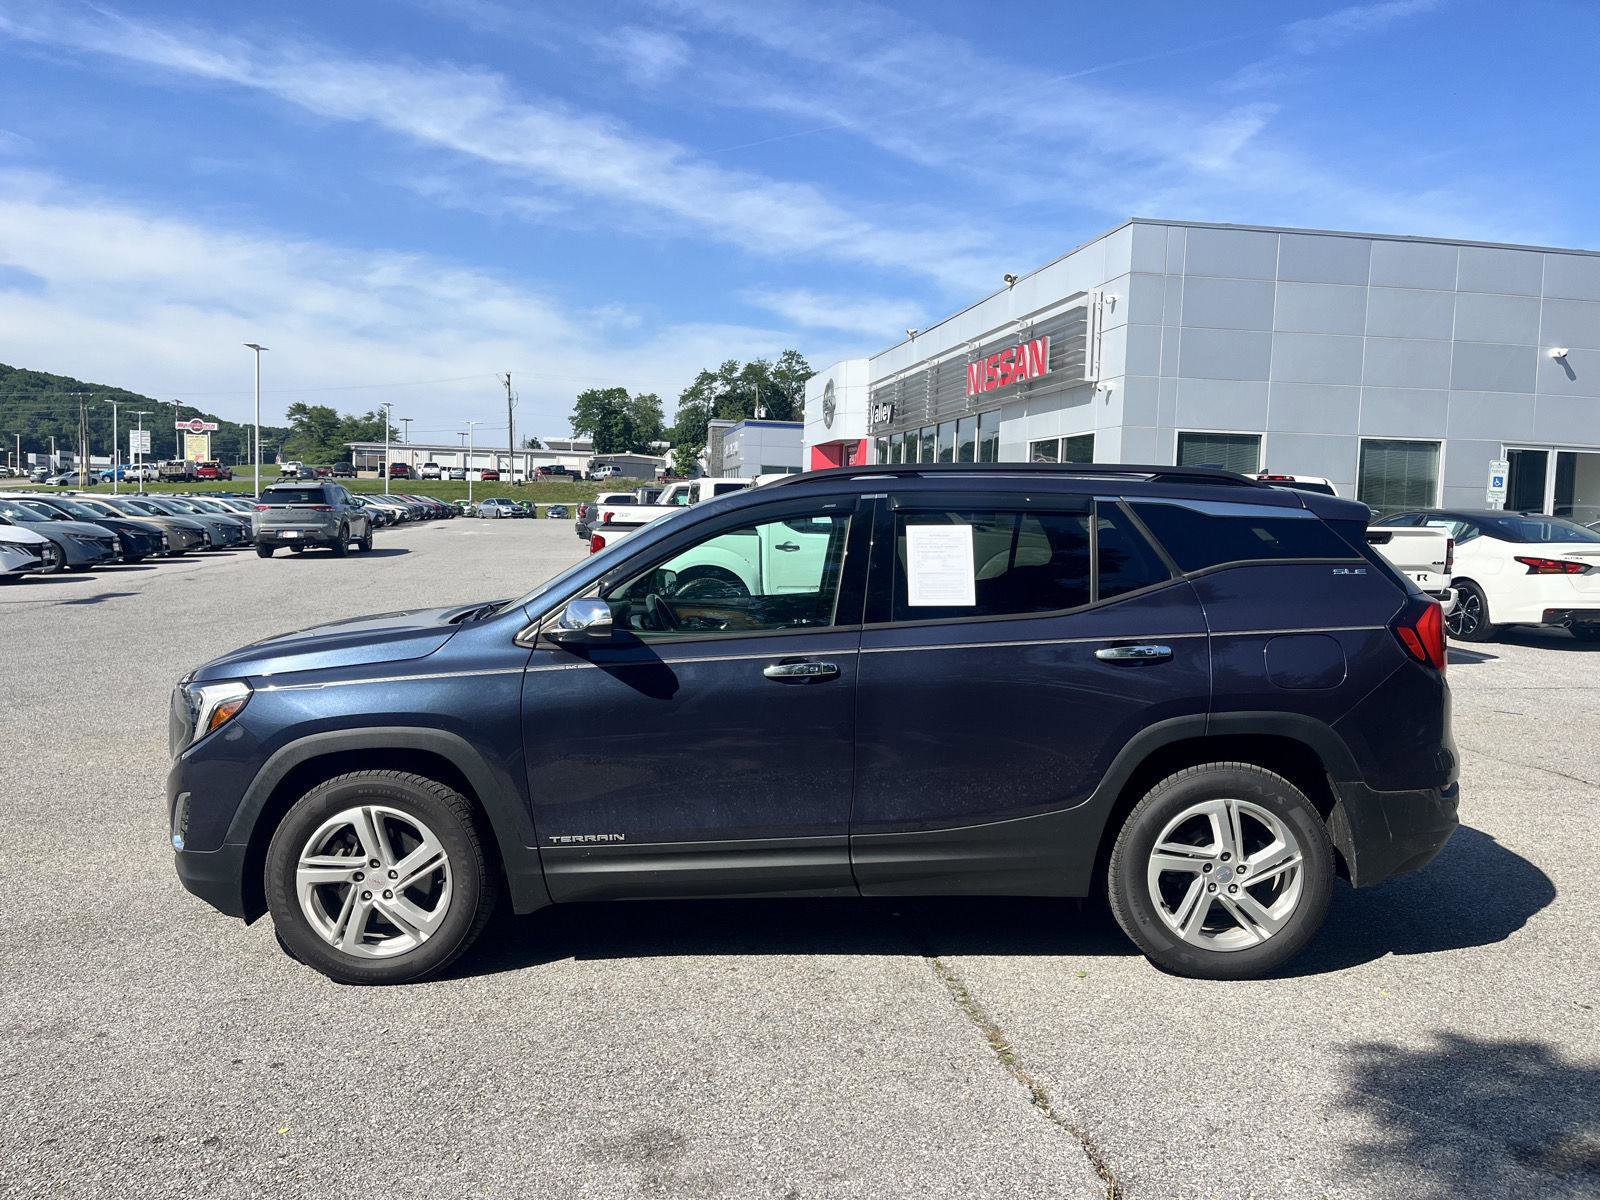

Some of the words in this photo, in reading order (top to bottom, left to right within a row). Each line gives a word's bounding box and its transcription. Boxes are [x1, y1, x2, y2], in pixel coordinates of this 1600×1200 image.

[966, 335, 1050, 397] NISSAN
[870, 402, 892, 425] Valley
[549, 833, 625, 843] TERRAIN
